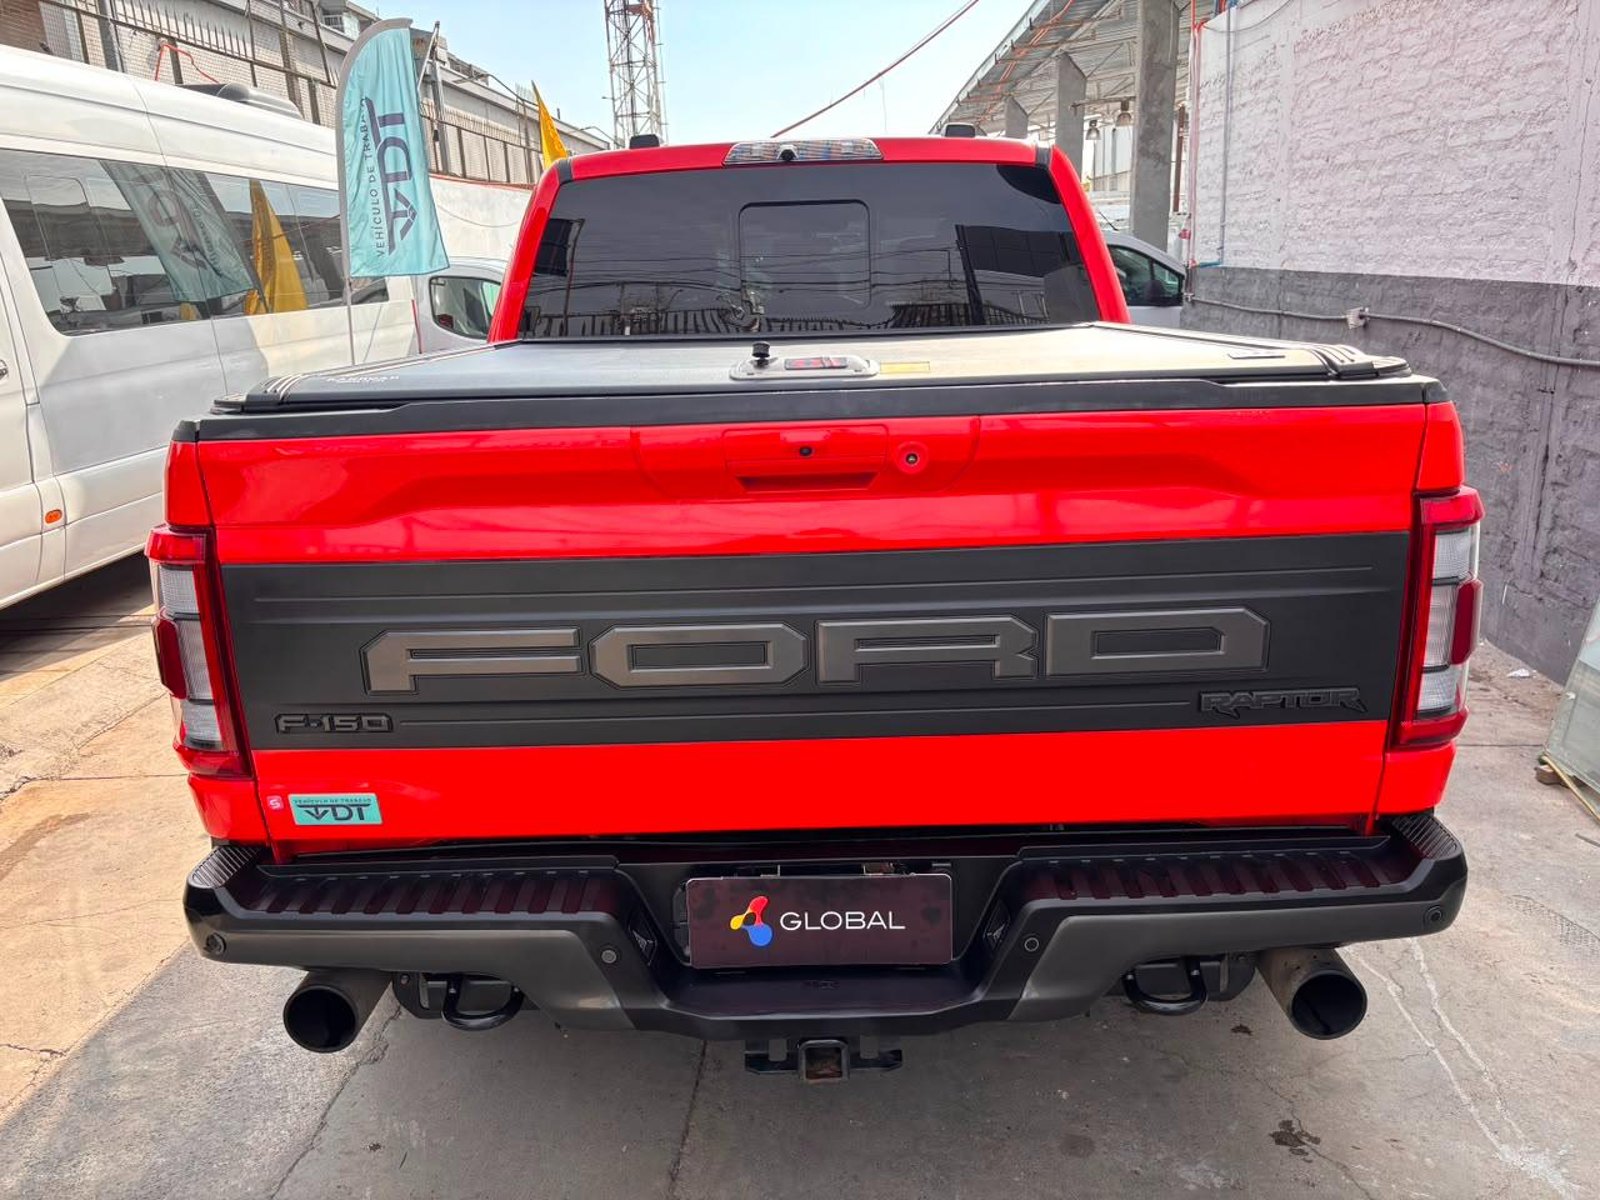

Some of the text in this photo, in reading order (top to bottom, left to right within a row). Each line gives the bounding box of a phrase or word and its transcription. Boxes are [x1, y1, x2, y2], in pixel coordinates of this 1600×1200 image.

[360, 98, 386, 257] VEHÍCULO DE TRABAO
[363, 607, 1268, 694] FORD
[1201, 687, 1368, 719] RAPTOR
[276, 713, 392, 733] F-150
[779, 910, 906, 931] GLOBAL
